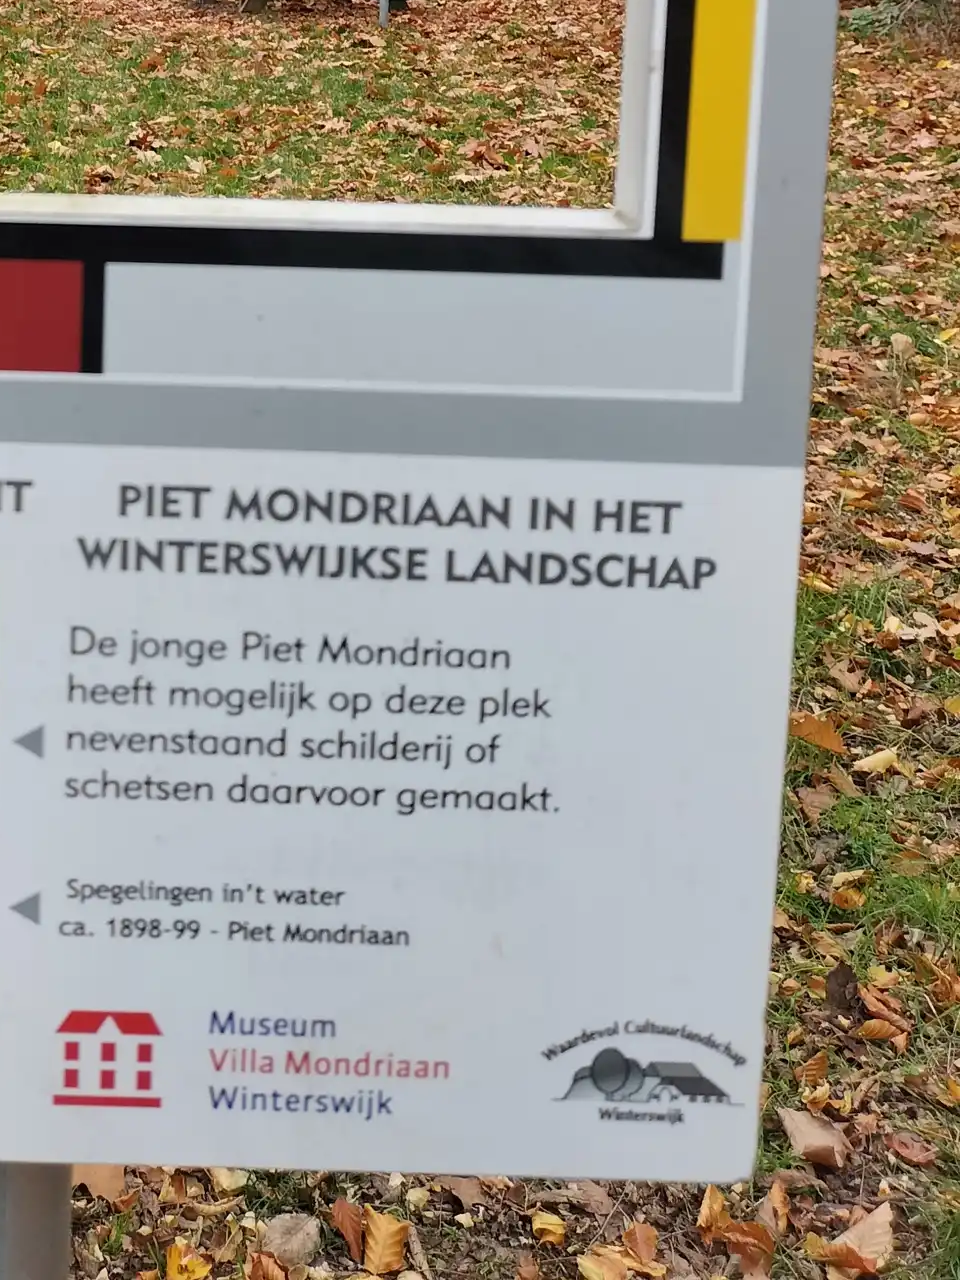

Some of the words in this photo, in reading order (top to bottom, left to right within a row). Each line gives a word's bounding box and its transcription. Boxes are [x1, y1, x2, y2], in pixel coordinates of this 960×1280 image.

[119, 484, 213, 519] PIET
[224, 488, 511, 530] MONDRIAAN
[529, 497, 575, 531] IN
[593, 499, 683, 535] HET
[77, 537, 428, 582] WINTERSWIJKSE
[445, 549, 717, 590] LANDSCHAP
[69, 625, 118, 658] De
[129, 629, 228, 668] jonge
[241, 630, 306, 663] Piet
[317, 635, 511, 670] Mondriaan
[67, 673, 156, 706] heeft
[168, 680, 317, 719] mogelijk
[328, 691, 373, 720] op
[384, 684, 466, 716] deze
[478, 687, 552, 724] plek
[66, 727, 287, 758] nevenstaand
[300, 729, 453, 771] schilderij
[465, 734, 501, 764] of
[65, 769, 214, 802] schetsen
[226, 773, 386, 807] daarvoor
[396, 782, 559, 816] gemaakt.
[66, 878, 214, 908] Spegelingen
[273, 888, 346, 907] water
[58, 920, 95, 937] ca.
[107, 917, 201, 940] 1898-99
[227, 920, 275, 943] Piet
[282, 923, 410, 946] Mondriaan
[208, 1010, 336, 1038] Museum
[540, 1021, 619, 1061] Waardevol
[623, 1019, 747, 1067] Cultuurlandschap
[208, 1047, 275, 1074] Villa
[284, 1050, 450, 1079] Mondriaan
[208, 1085, 393, 1122] Winterswijk
[598, 1107, 685, 1125] Winterswijk
